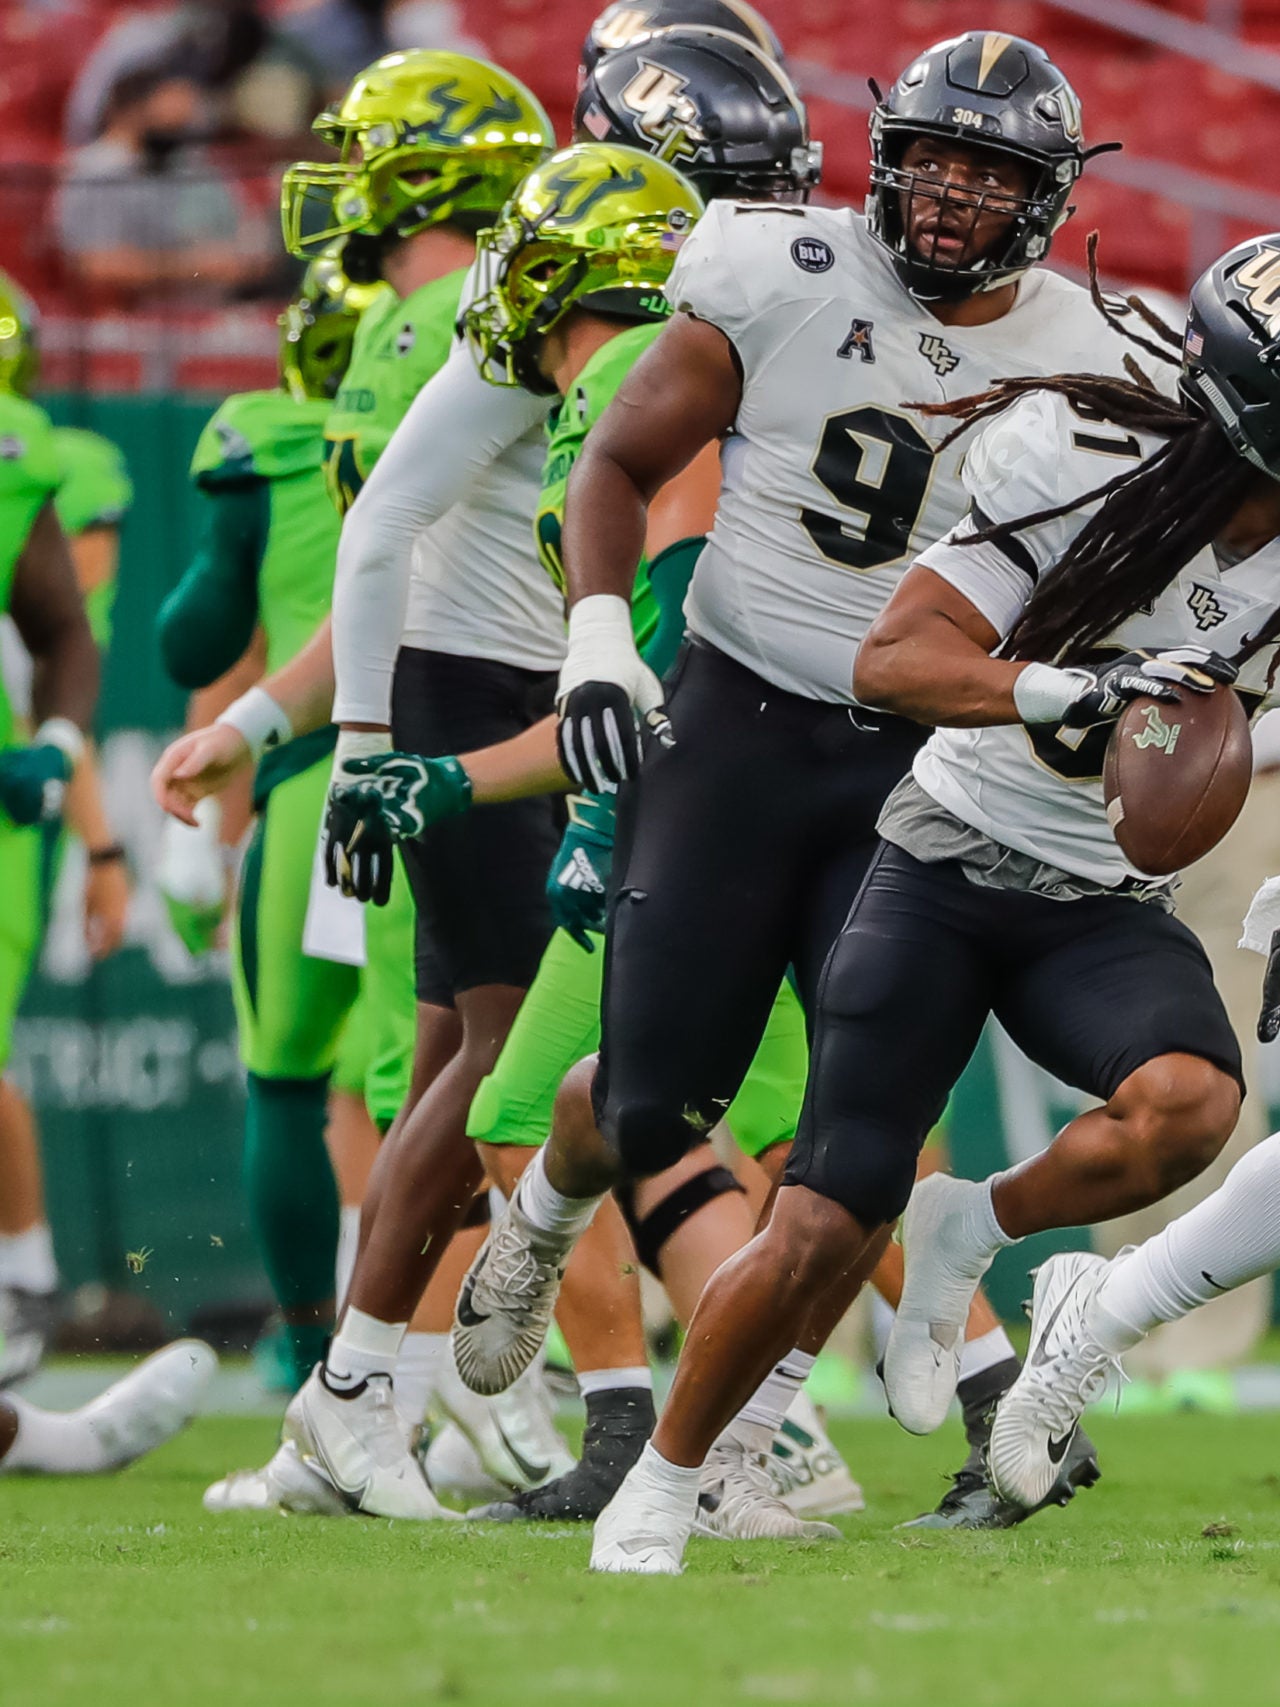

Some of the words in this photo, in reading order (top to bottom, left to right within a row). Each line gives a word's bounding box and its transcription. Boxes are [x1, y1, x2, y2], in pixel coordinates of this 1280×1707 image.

[952, 107, 983, 129] 304
[799, 244, 828, 264] BLM
[918, 331, 961, 377] UCF
[797, 401, 966, 574] 9
[1186, 582, 1228, 632] UCF
